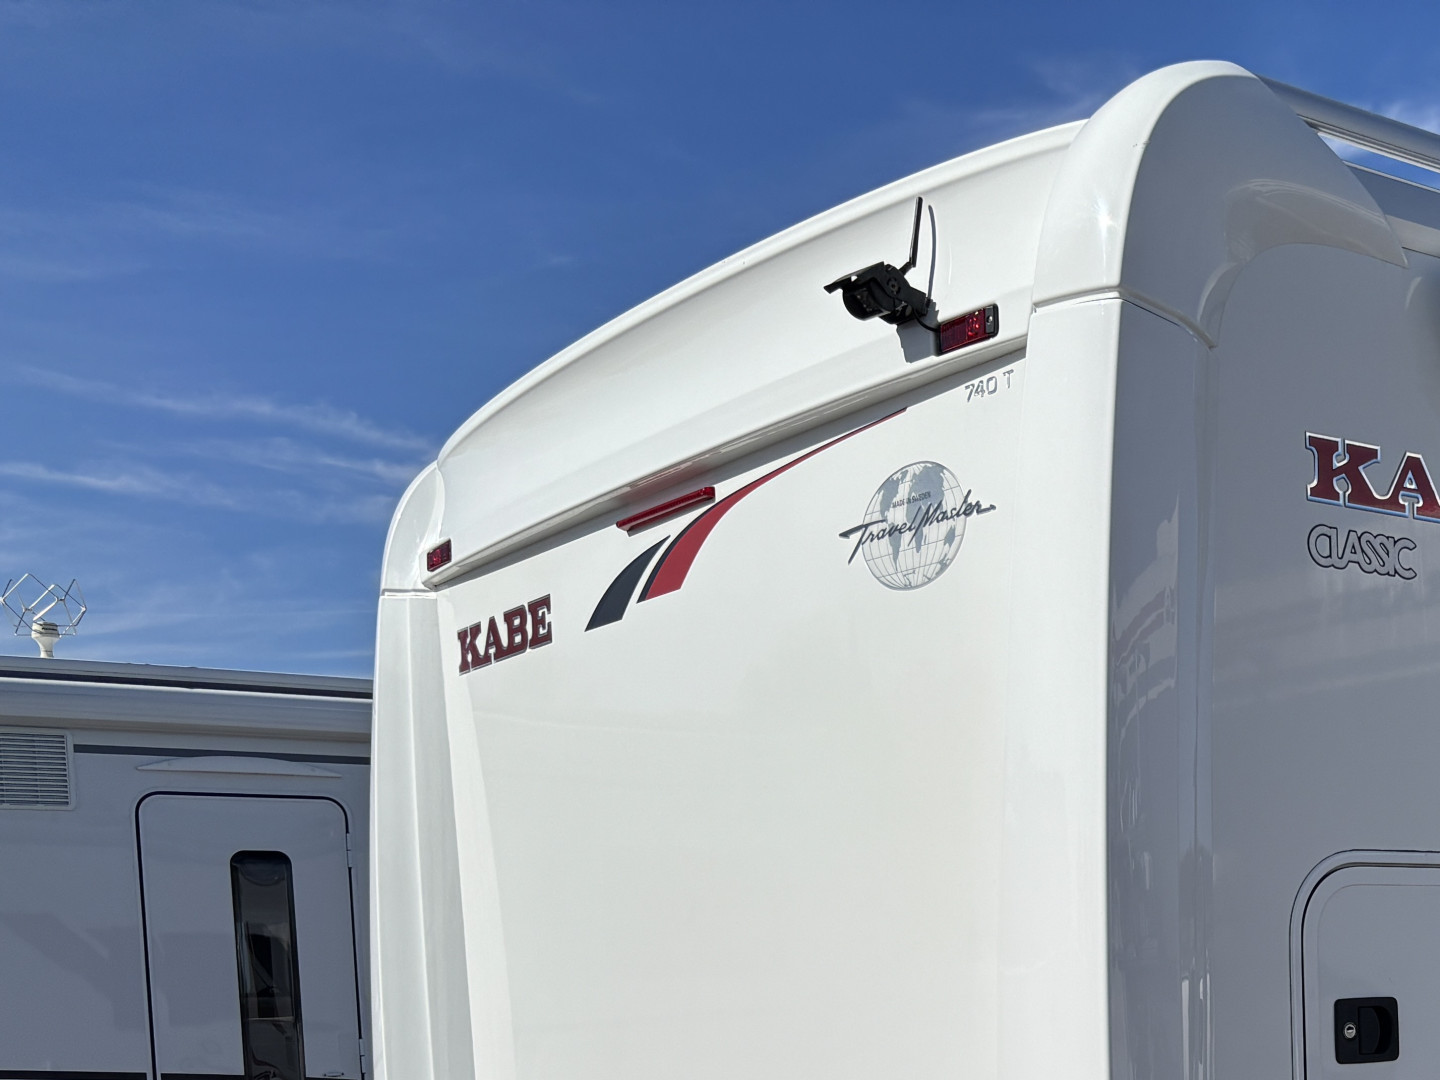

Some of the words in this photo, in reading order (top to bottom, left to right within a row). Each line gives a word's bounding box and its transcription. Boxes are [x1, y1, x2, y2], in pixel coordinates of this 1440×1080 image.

[964, 376, 998, 403] 740
[1002, 368, 1014, 389] T
[838, 504, 922, 566] Travel
[907, 489, 997, 547] Master
[1307, 523, 1418, 580] CLASSIC
[457, 593, 553, 676] KABE
